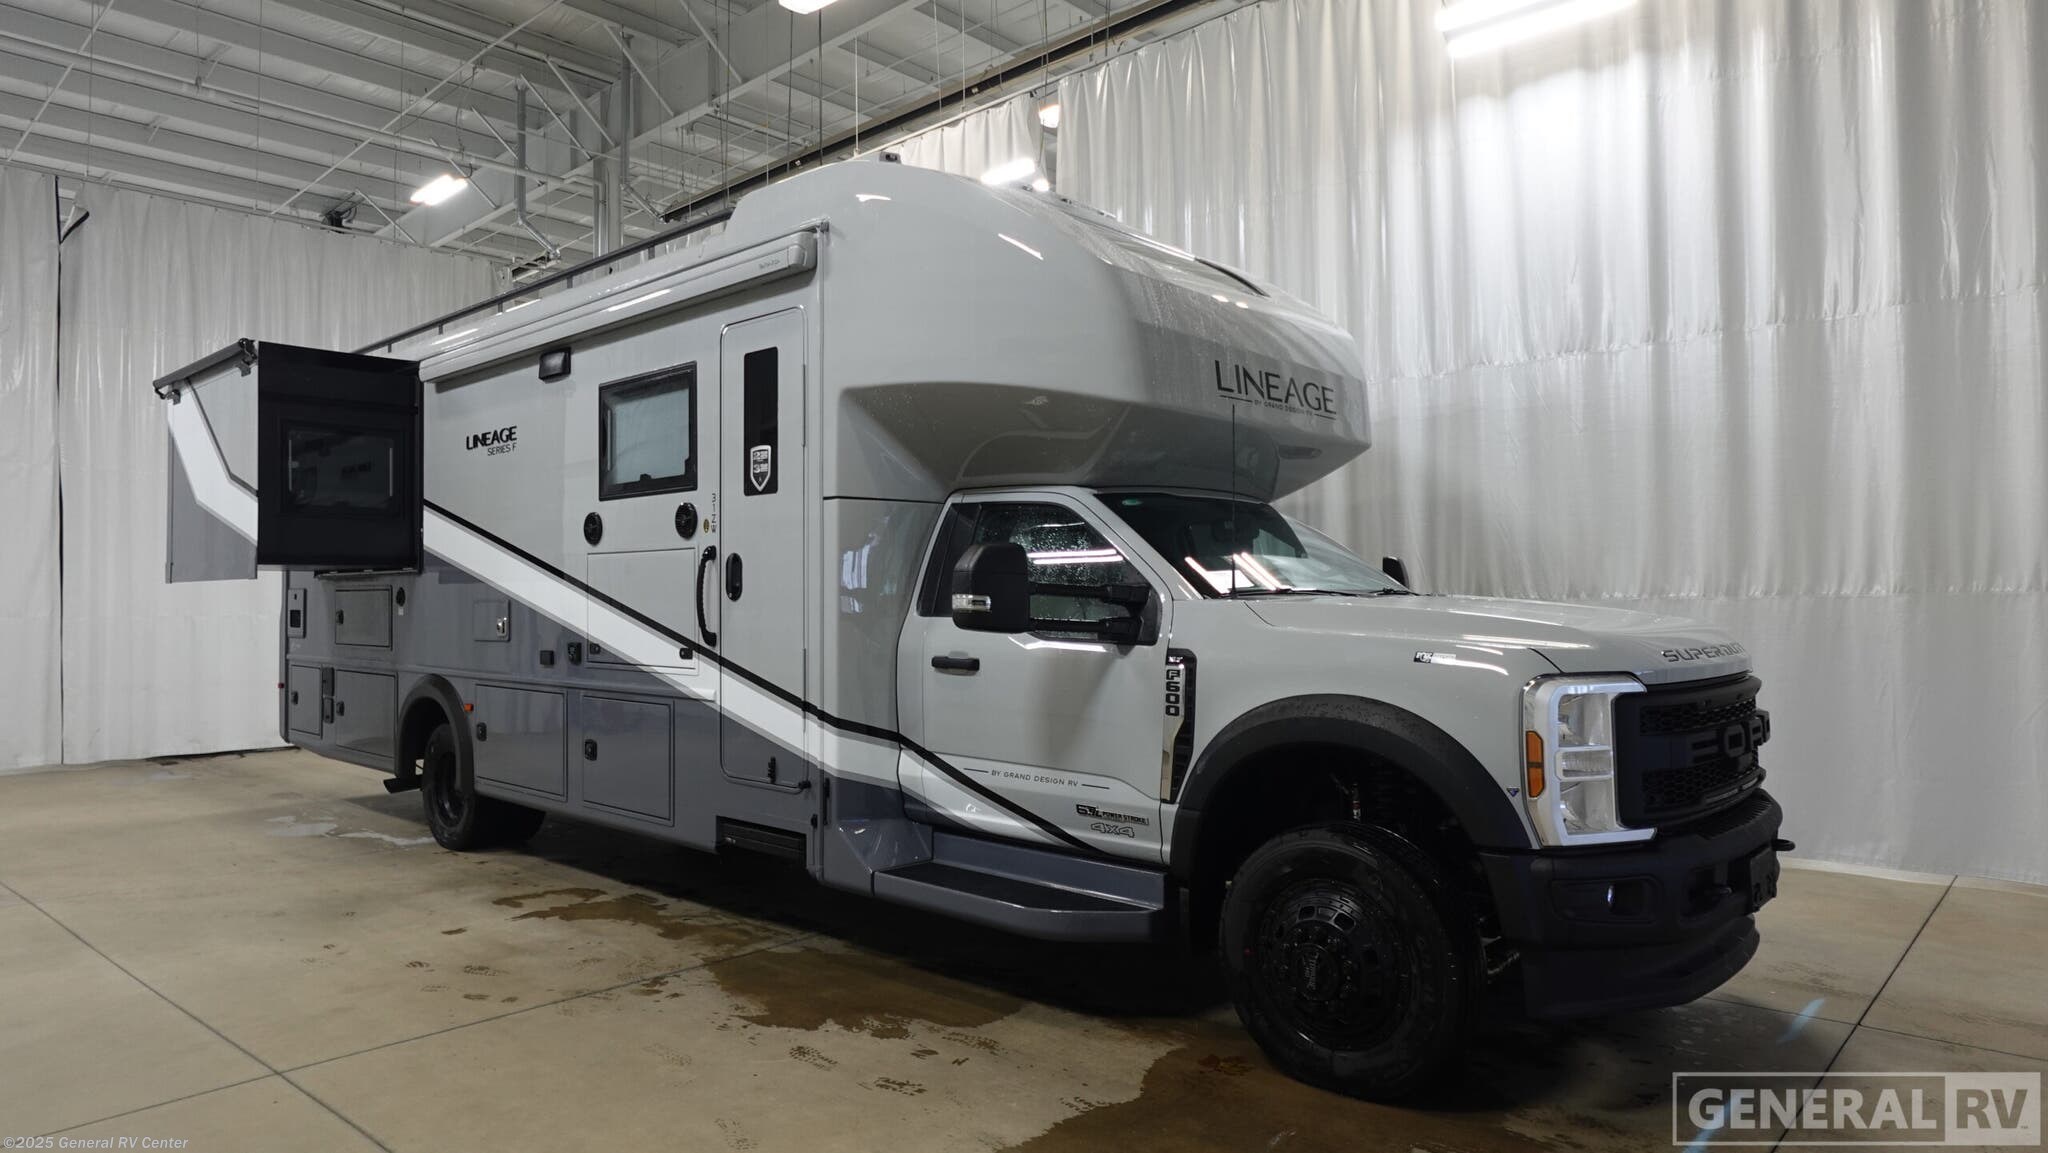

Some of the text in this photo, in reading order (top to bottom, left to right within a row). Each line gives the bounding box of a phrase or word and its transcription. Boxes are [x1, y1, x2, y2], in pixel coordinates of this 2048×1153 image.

[1215, 360, 1337, 415] LINEAGE
[466, 425, 517, 450] LINEAGE
[487, 443, 511, 456] SERIES
[1165, 669, 1180, 716] F600
[1688, 710, 1771, 764] FORD
[991, 769, 1001, 777] BY
[1003, 771, 1031, 781] GRAND
[1034, 775, 1065, 785] DESIGN
